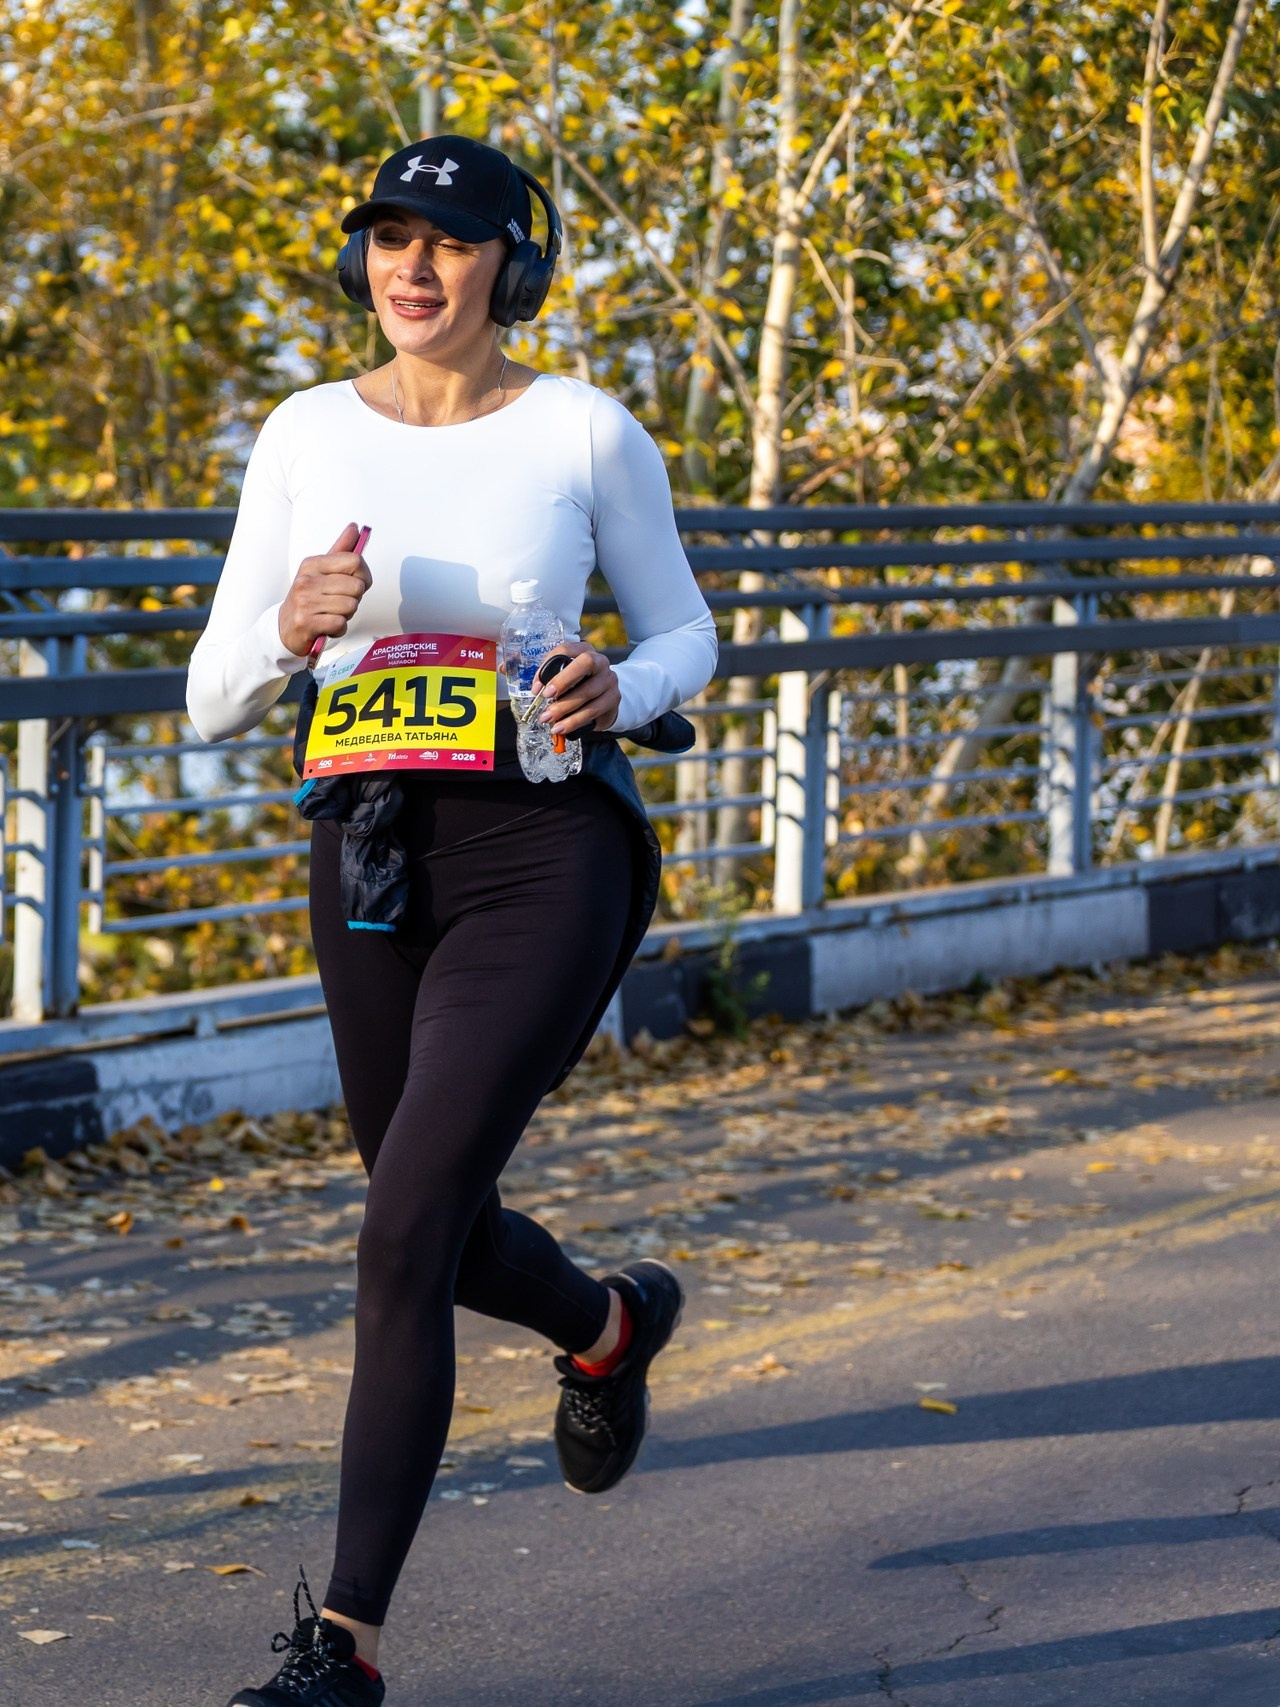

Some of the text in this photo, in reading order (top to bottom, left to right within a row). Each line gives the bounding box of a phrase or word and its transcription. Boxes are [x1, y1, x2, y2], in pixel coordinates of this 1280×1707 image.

[372, 643, 437, 656] КРАСНОЯРСКИЕ
[387, 650, 418, 660] МОСТЫ
[460, 649, 484, 660] 5 КМ
[337, 663, 355, 675] СБЕР
[323, 675, 477, 736] 5415
[335, 731, 458, 748] МЕДВЕДЕВА ТАТЬЯНА
[451, 752, 476, 761] 2026
